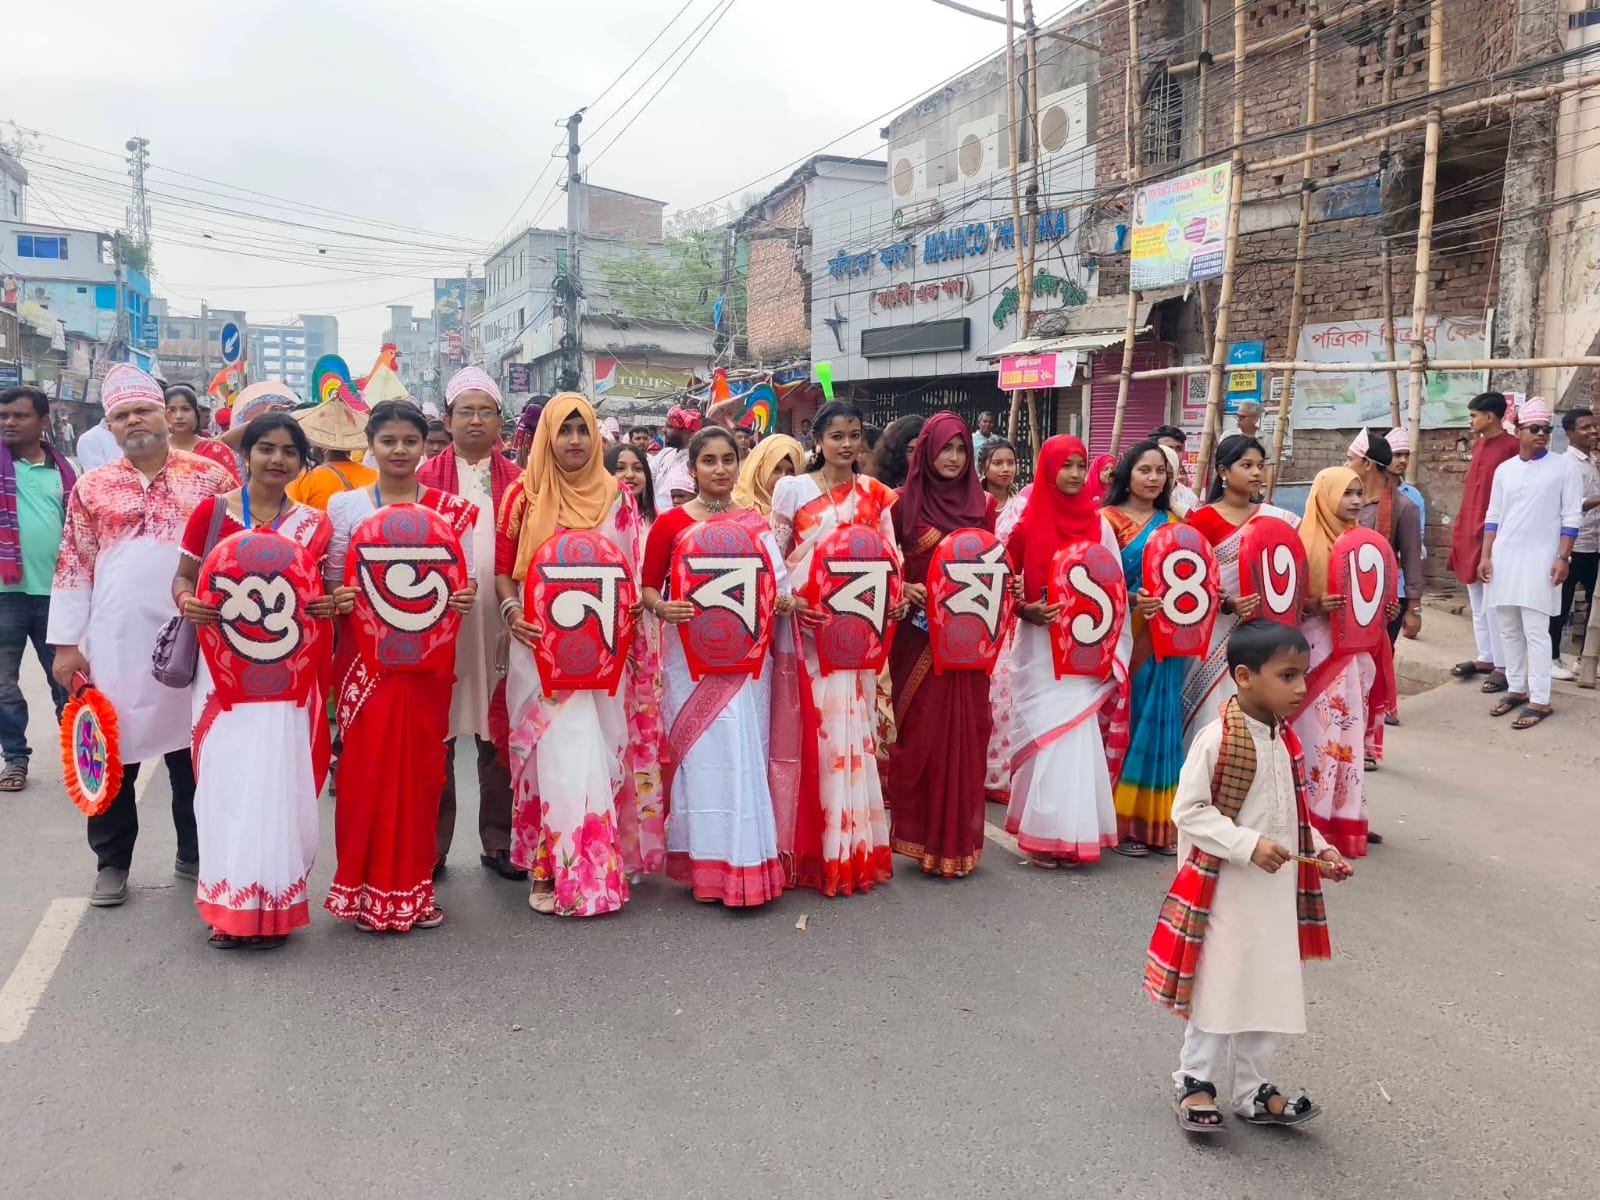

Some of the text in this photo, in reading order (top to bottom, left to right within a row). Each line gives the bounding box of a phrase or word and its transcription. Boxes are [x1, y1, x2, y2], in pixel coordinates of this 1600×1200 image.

[1311, 326, 1374, 350] পত্রিকা
[356, 543, 458, 632] ভ
[539, 563, 629, 655] ন
[683, 553, 769, 641] ব
[822, 556, 898, 642] ব
[1067, 563, 1114, 646] ১
[1159, 547, 1211, 627] ৪
